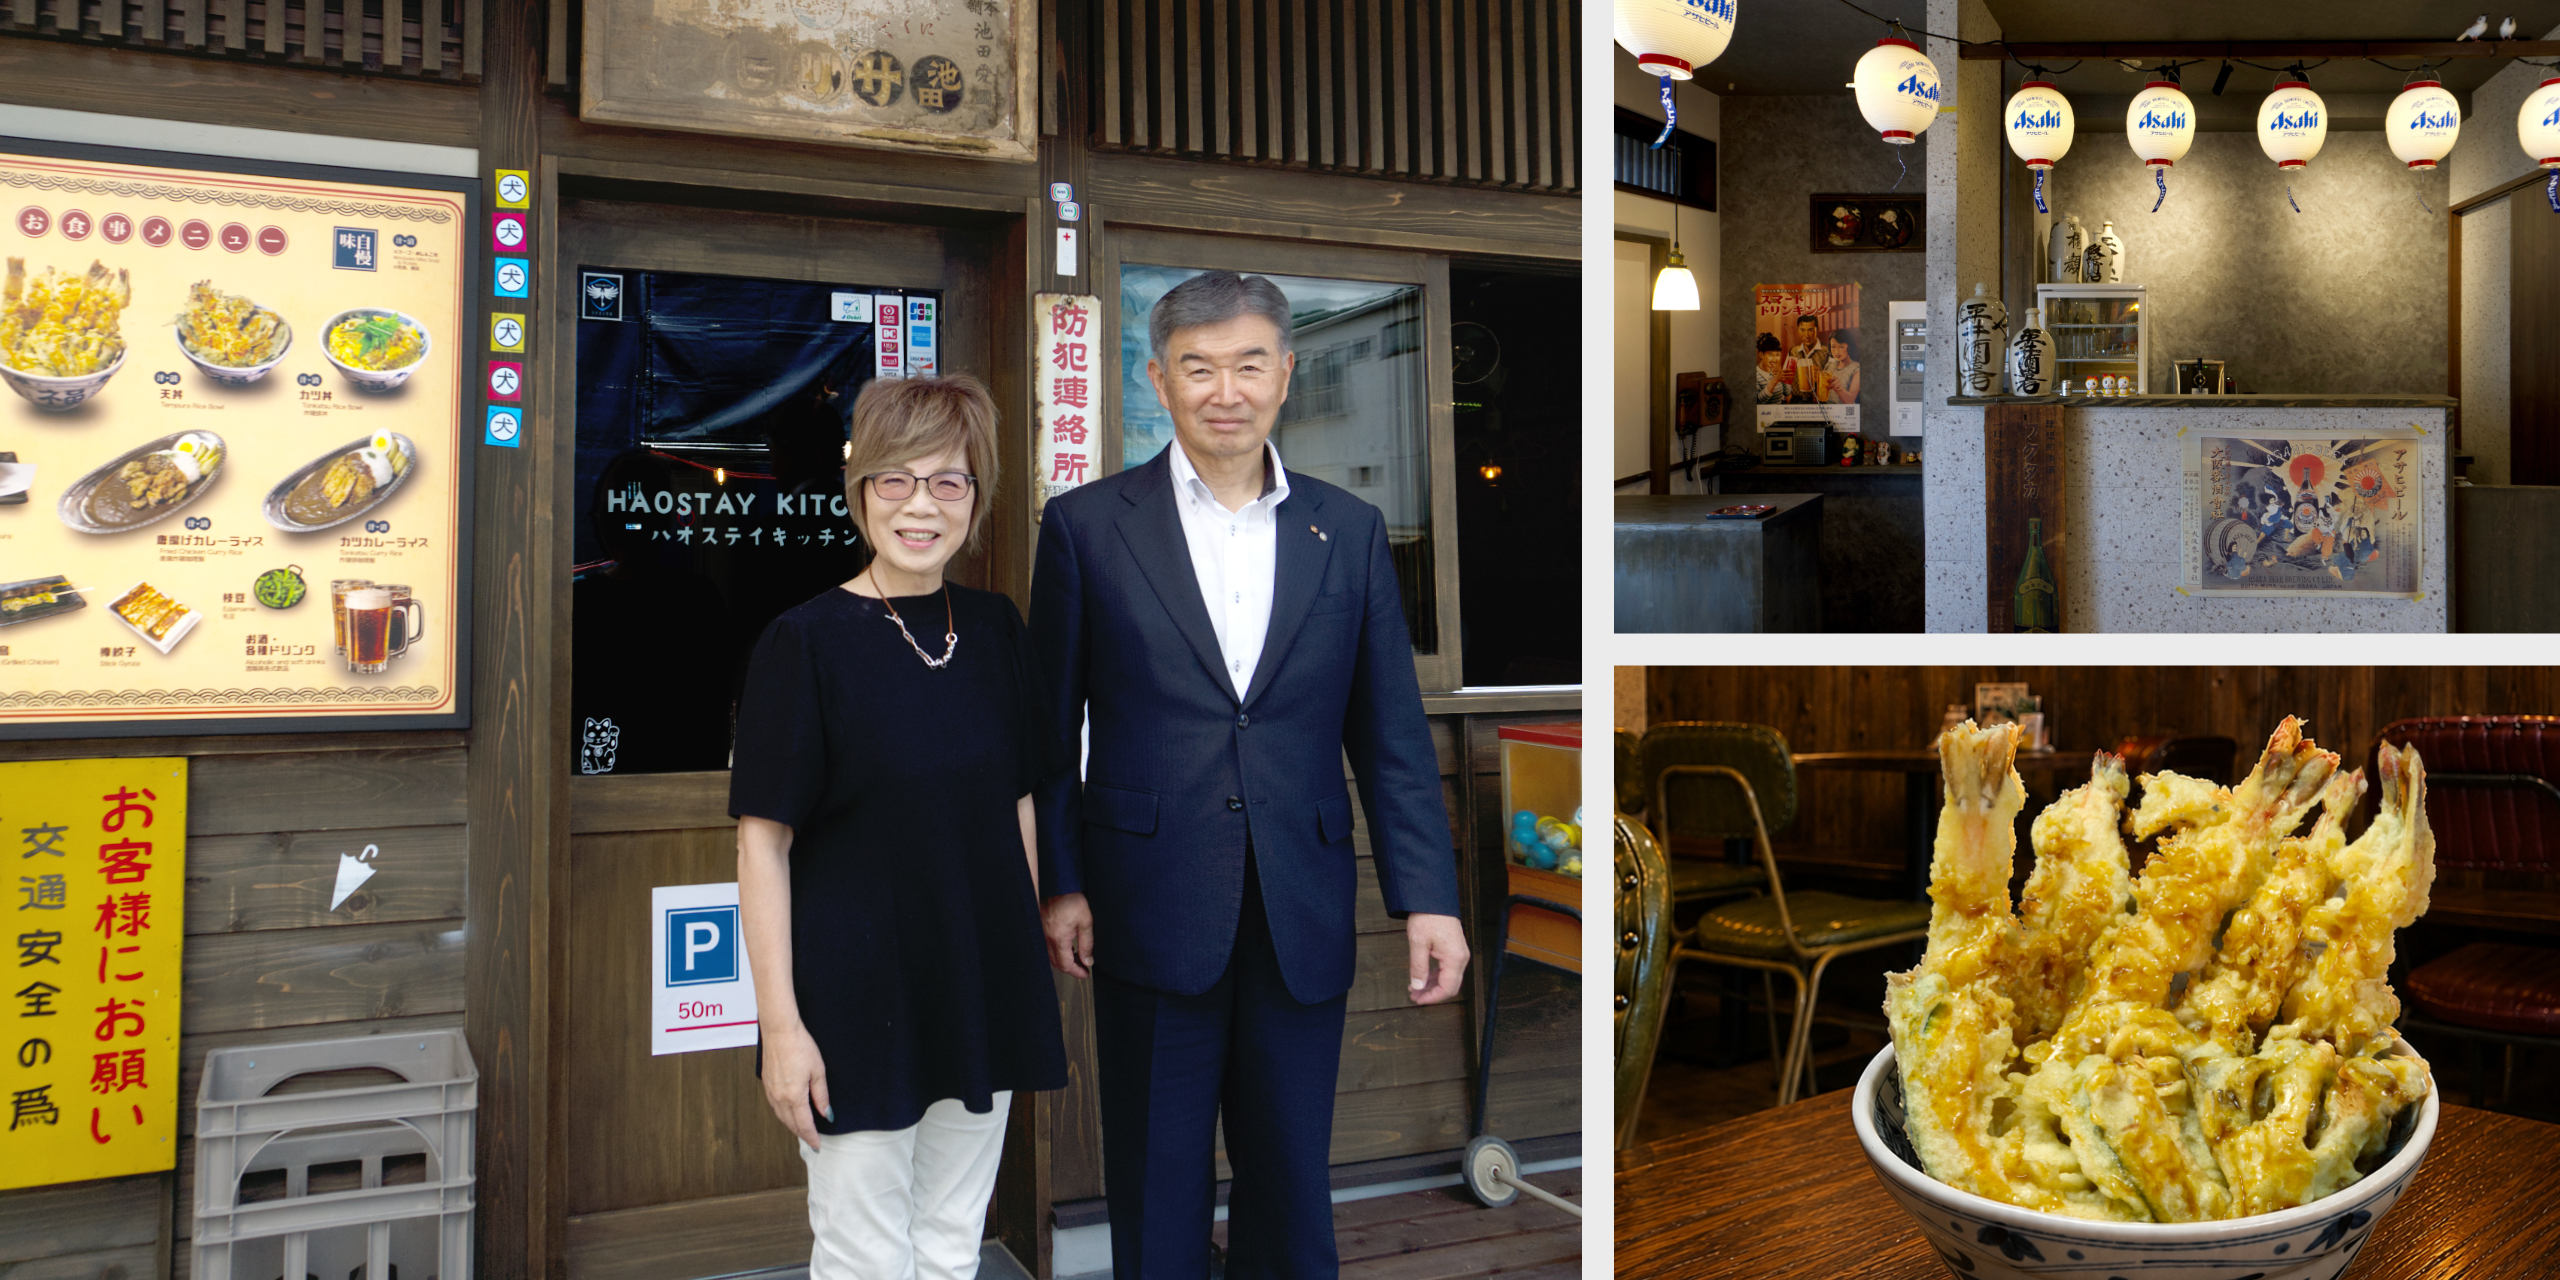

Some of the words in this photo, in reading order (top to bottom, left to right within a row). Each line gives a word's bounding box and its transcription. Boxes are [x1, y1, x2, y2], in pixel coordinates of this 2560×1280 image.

[2014, 109, 2060, 129] Asahi
[2138, 109, 2186, 129] Asahi
[2270, 110, 2318, 131] Asahi
[2410, 110, 2457, 130] Asahi
[503, 179, 522, 196] 犬
[25, 213, 281, 246] お食事メニュー
[500, 223, 519, 240] 犬
[502, 268, 521, 285] 犬
[1761, 294, 1804, 304] スマート
[1761, 305, 1831, 316] ドリンキング
[498, 322, 518, 341] 犬
[496, 370, 515, 390] 犬
[160, 389, 183, 400] 天丼
[300, 390, 332, 400] カツ丼
[1050, 304, 1090, 485] 防犯連絡所
[493, 417, 514, 434] 犬
[2392, 449, 2408, 521] アサヒビール
[607, 489, 756, 517] HAOSTAY
[777, 493, 850, 517] KITC
[156, 535, 264, 546] 唐揚げカレーライス
[340, 537, 428, 548] カツカレーライス
[651, 526, 859, 546] ハオステイキッチン
[222, 593, 246, 603] 枝豆
[100, 646, 136, 658] 棒餃子
[246, 646, 315, 656] 各種ドリンク
[685, 921, 720, 971] P
[90, 786, 156, 1144] お客様にお願い
[9, 822, 69, 1131] 交通安全の爲
[678, 1001, 723, 1019] 50m
